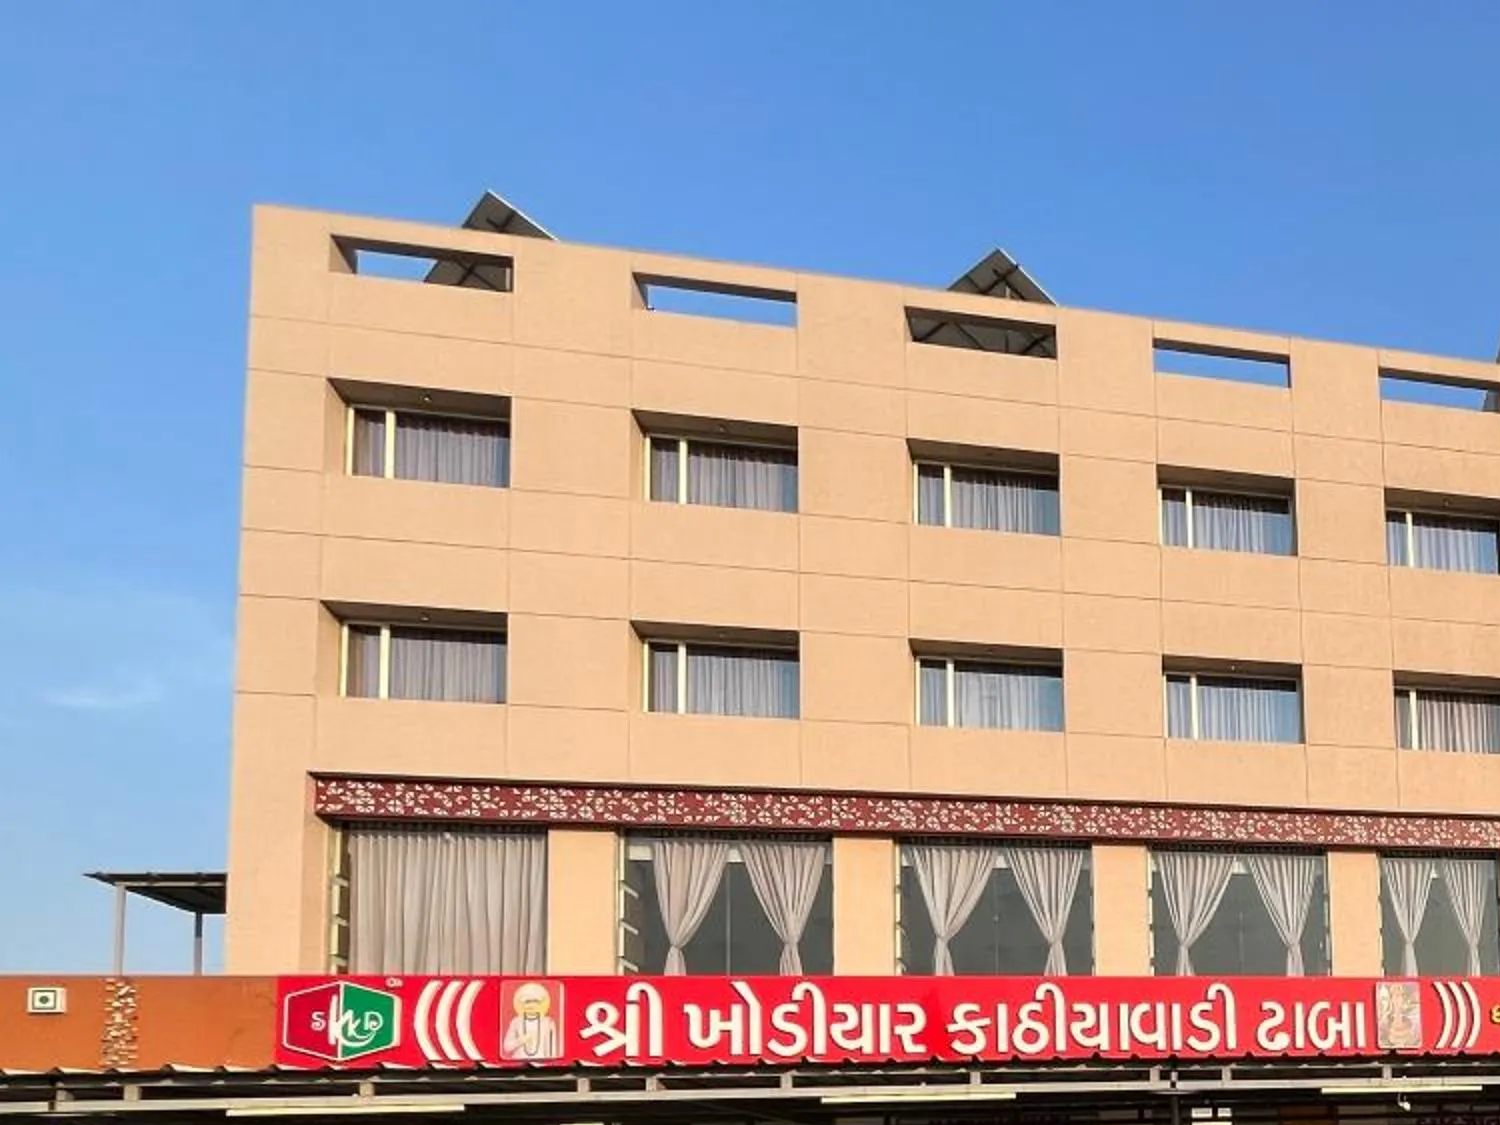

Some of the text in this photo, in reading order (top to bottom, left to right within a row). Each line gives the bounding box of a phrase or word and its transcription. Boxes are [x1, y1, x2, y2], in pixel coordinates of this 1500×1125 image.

[579, 981, 1365, 1058] શ્રી ખોડીયાર કાઠીયાવાડી ઢાબા
